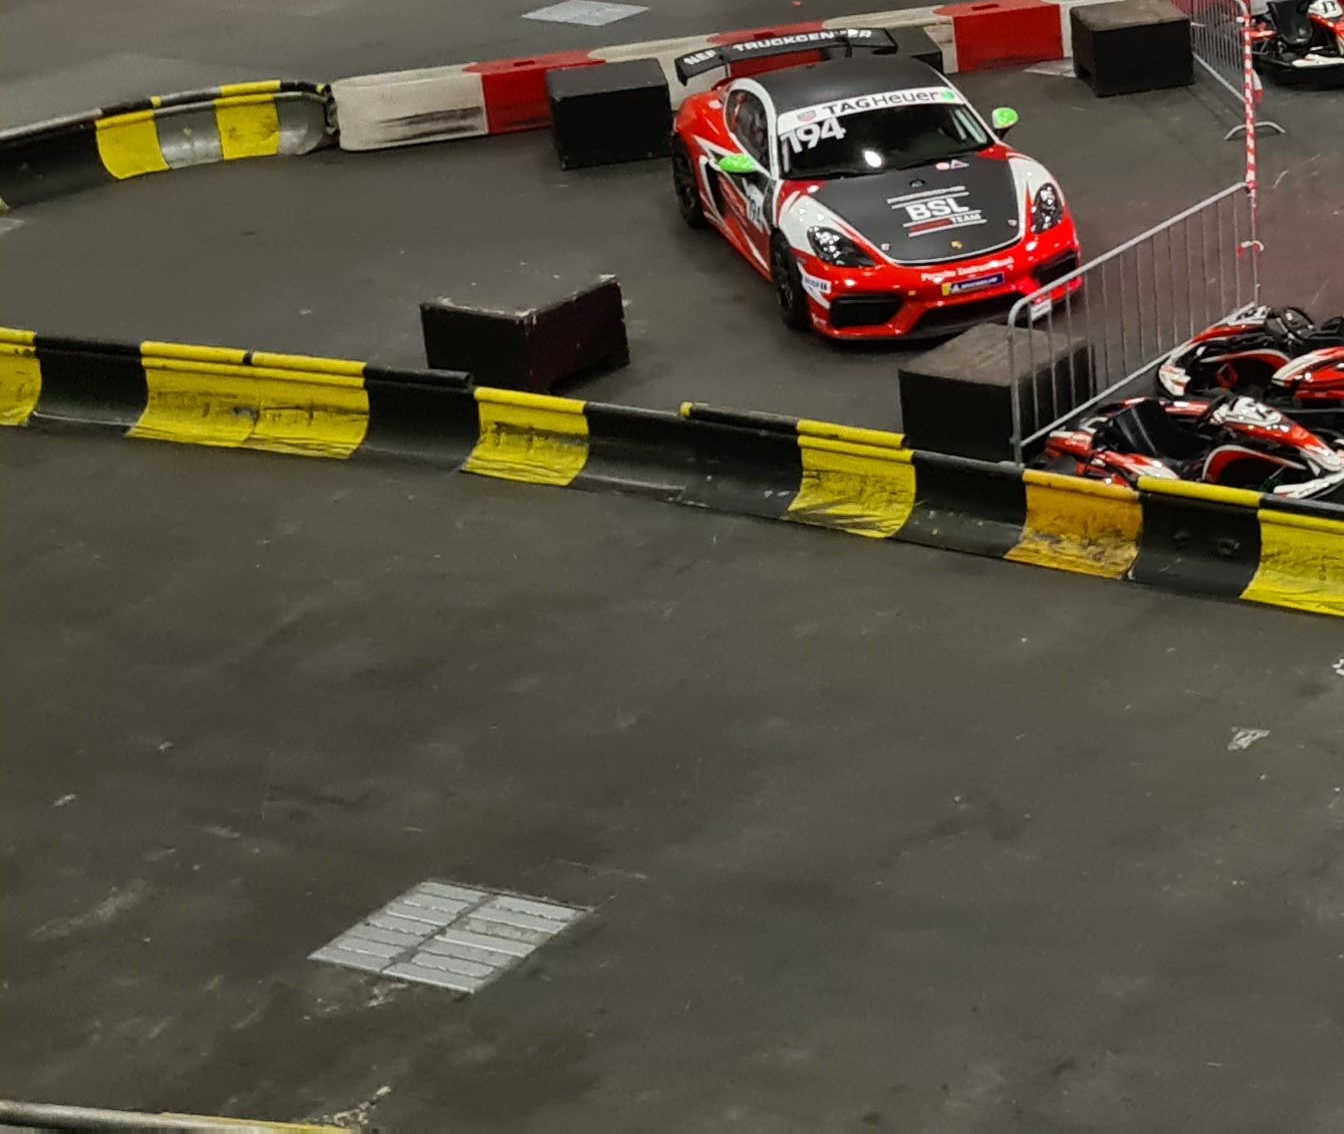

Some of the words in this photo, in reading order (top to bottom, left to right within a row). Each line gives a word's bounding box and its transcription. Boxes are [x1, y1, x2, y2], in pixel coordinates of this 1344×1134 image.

[733, 28, 873, 52] TRUCKCENER
[781, 116, 847, 154] 194
[905, 198, 970, 222] BSL
[951, 213, 982, 224] TEAM
